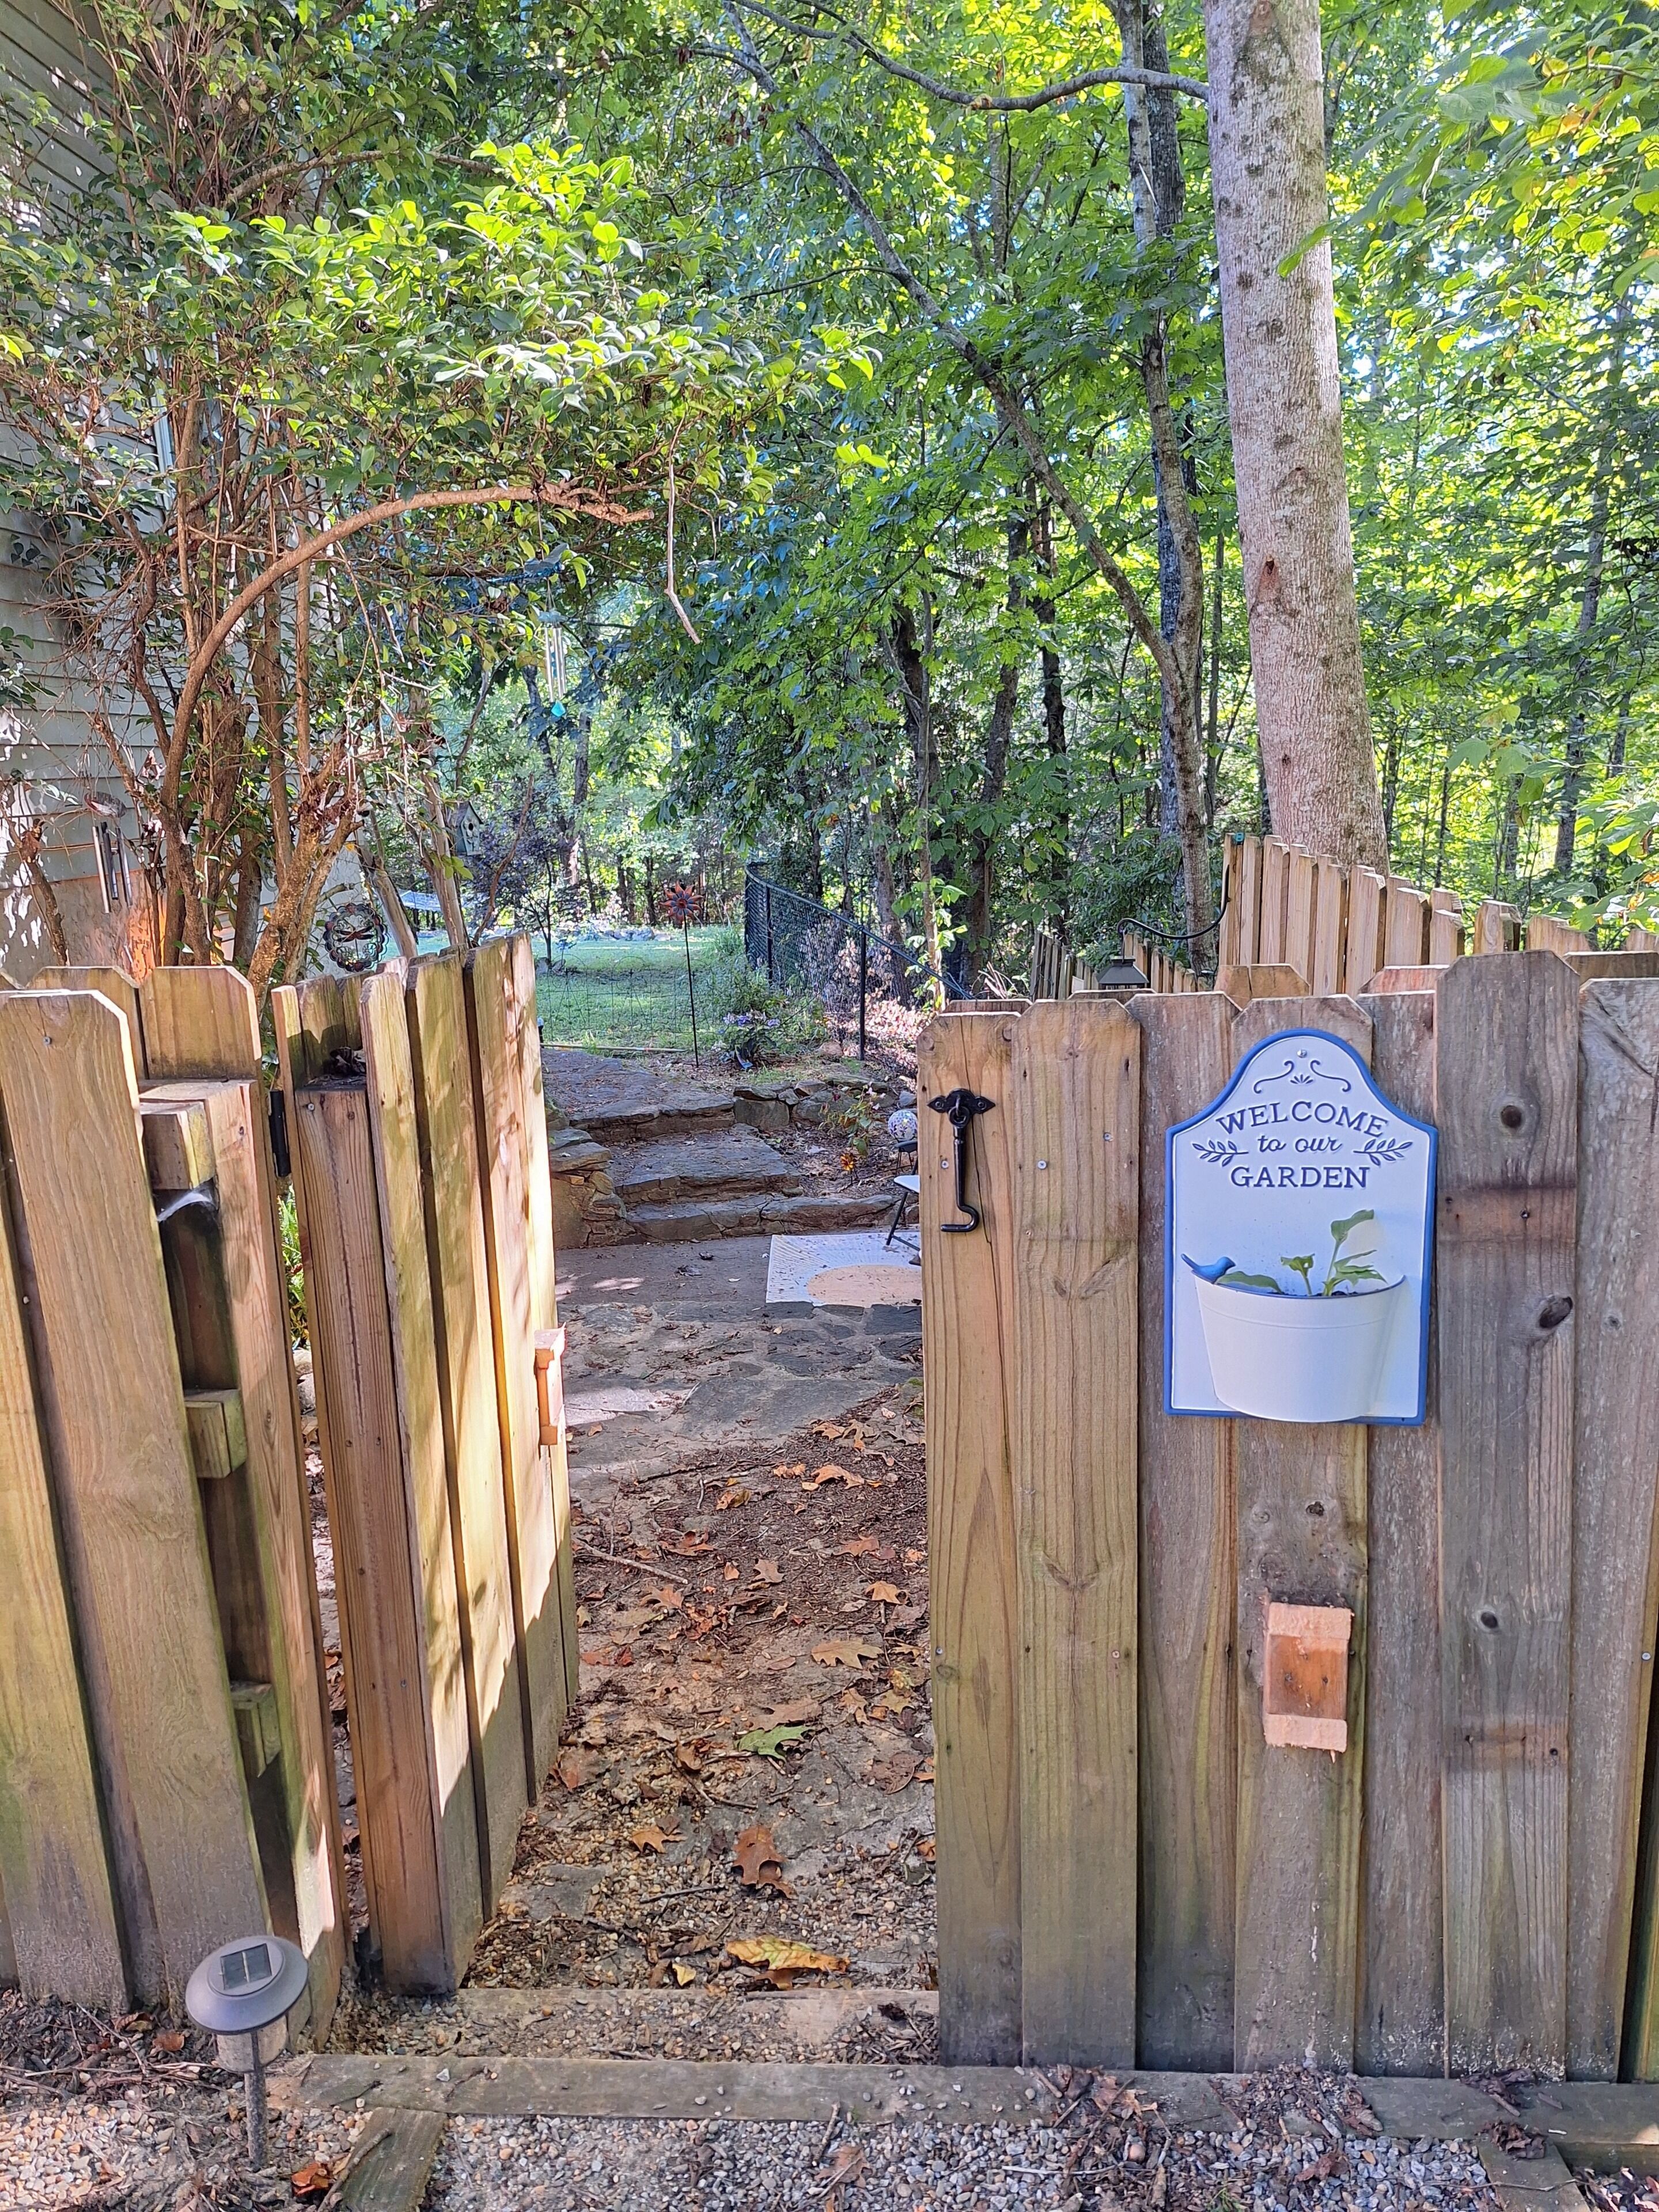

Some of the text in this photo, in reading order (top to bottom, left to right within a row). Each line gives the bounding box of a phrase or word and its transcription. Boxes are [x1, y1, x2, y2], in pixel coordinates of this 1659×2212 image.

[1215, 1101, 1389, 1138] WELCOME
[1257, 1135, 1343, 1152] to our
[1230, 1166, 1370, 1188] GARDEN
